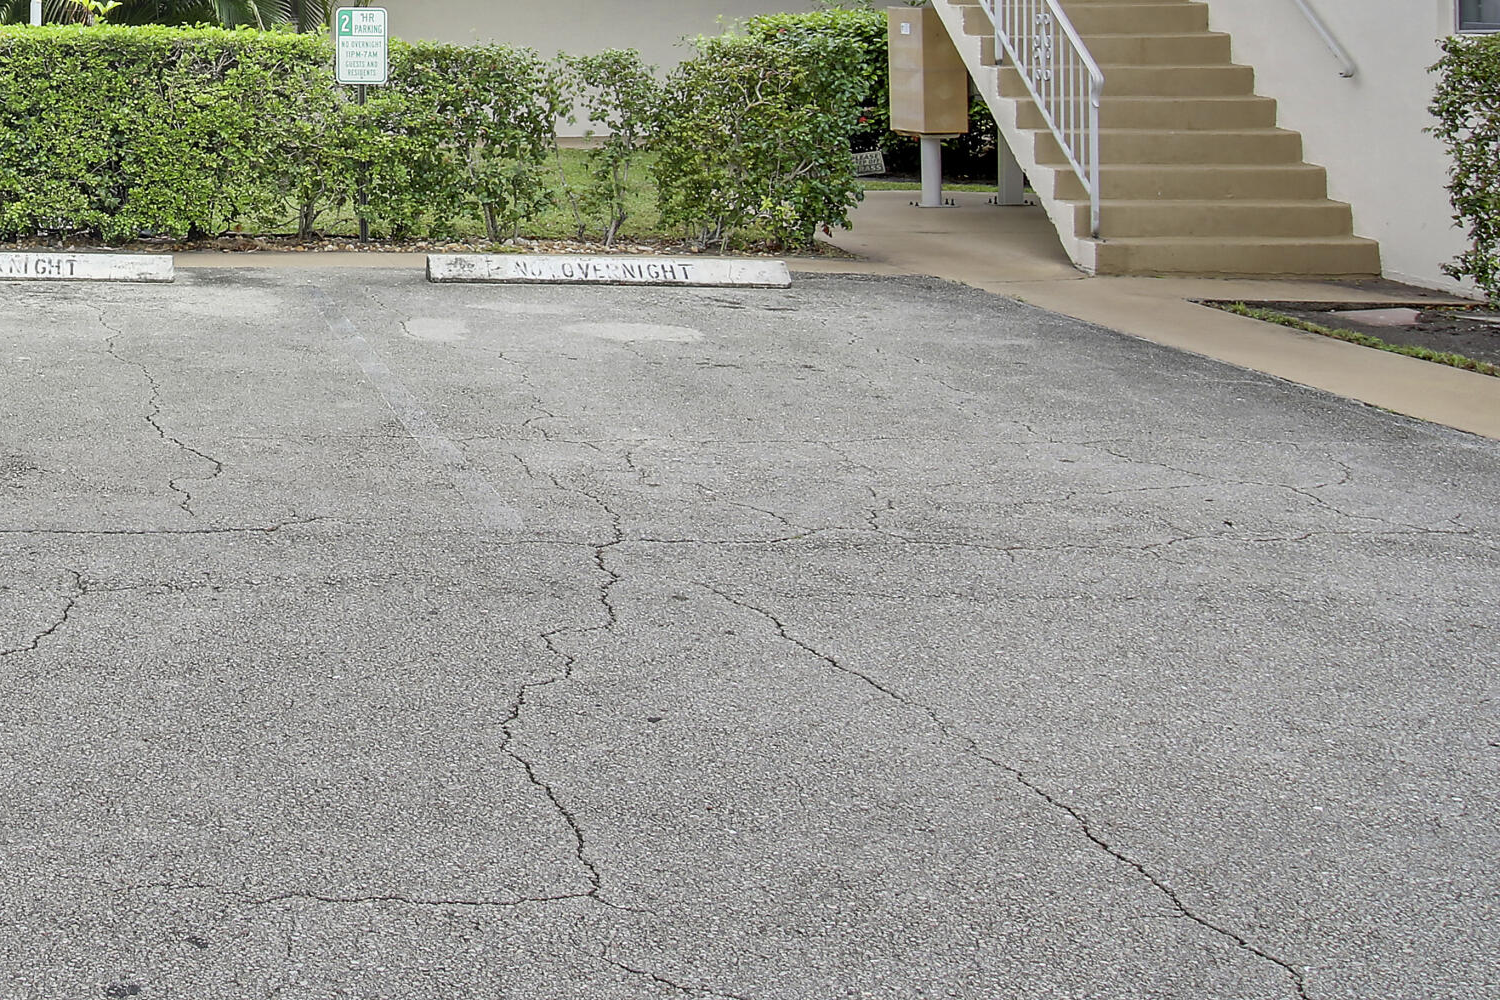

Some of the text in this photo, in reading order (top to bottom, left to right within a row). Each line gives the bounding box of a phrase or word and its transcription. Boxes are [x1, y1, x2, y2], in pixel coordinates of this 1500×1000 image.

[361, 13, 375, 22] HR
[341, 14, 350, 32] 2
[354, 25, 382, 33] PARKING
